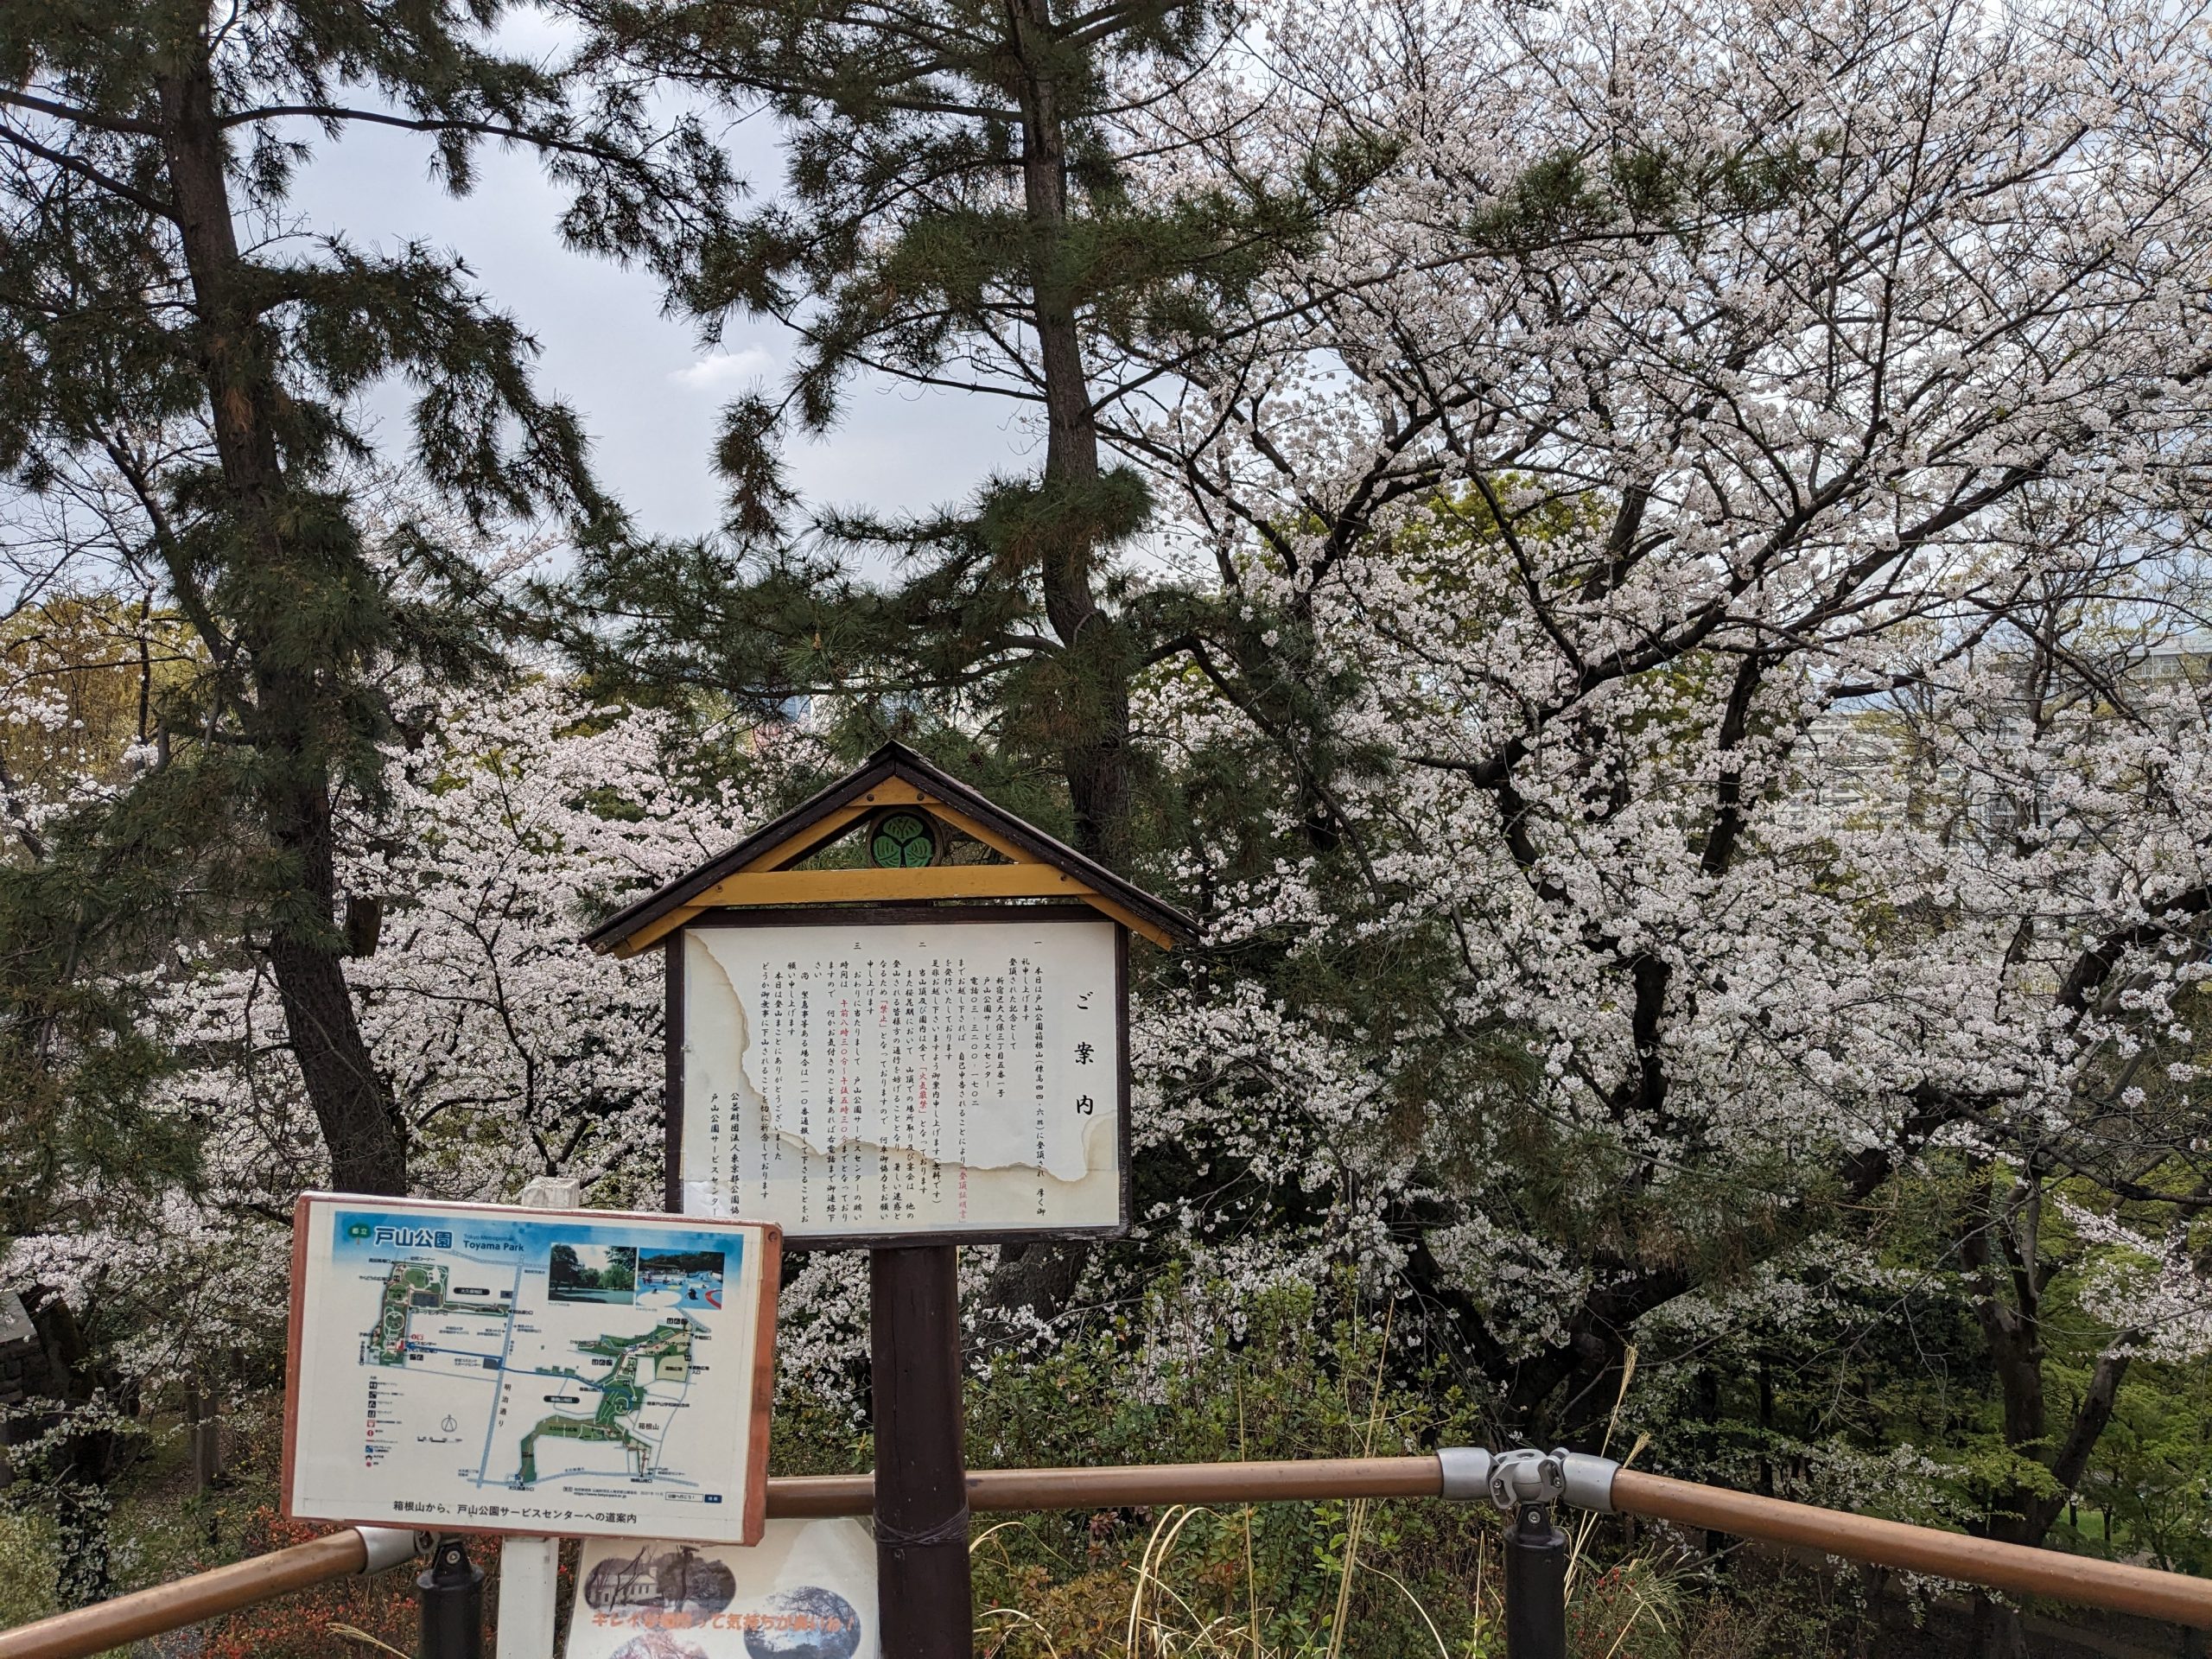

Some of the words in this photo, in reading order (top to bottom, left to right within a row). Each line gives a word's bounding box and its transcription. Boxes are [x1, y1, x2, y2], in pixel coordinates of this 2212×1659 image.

[787, 962, 796, 1036] 願い申し上げます
[815, 962, 822, 977] さい
[840, 961, 849, 988] 時間は
[957, 958, 966, 1041] までお越し下されば
[1009, 958, 1018, 1050] 登頂された記念として
[774, 971, 784, 1160] 本日は登山まことにありがとうございました
[892, 960, 902, 1154] 登山される皆様方の通行を妨げることとなり
[996, 976, 1005, 1097] 新宿区大久保三丁目五番一号
[1074, 992, 1094, 1115] ご案内
[760, 963, 771, 1198] どうか御無事に下山されることを切に祈念しております
[709, 1093, 719, 1215] 戸山公園サービスセンター
[730, 1093, 741, 1217] 公益財団法人東京都公園協
[906, 1066, 915, 1190] 山頂での場所取り及び宴会は
[893, 1162, 901, 1219] 著しい迷惑と
[906, 1203, 915, 1218] 他の
[1037, 1188, 1046, 1216] 厚く御
[375, 1227, 453, 1249] 戸山公園
[463, 1241, 500, 1251] Toyama
[503, 1243, 524, 1252] Park
[499, 1383, 512, 1427] 明治通り
[639, 1422, 660, 1431] 箱根山
[393, 1500, 638, 1524] 箱根山から、戸山公園サービスセンターへの道案内
